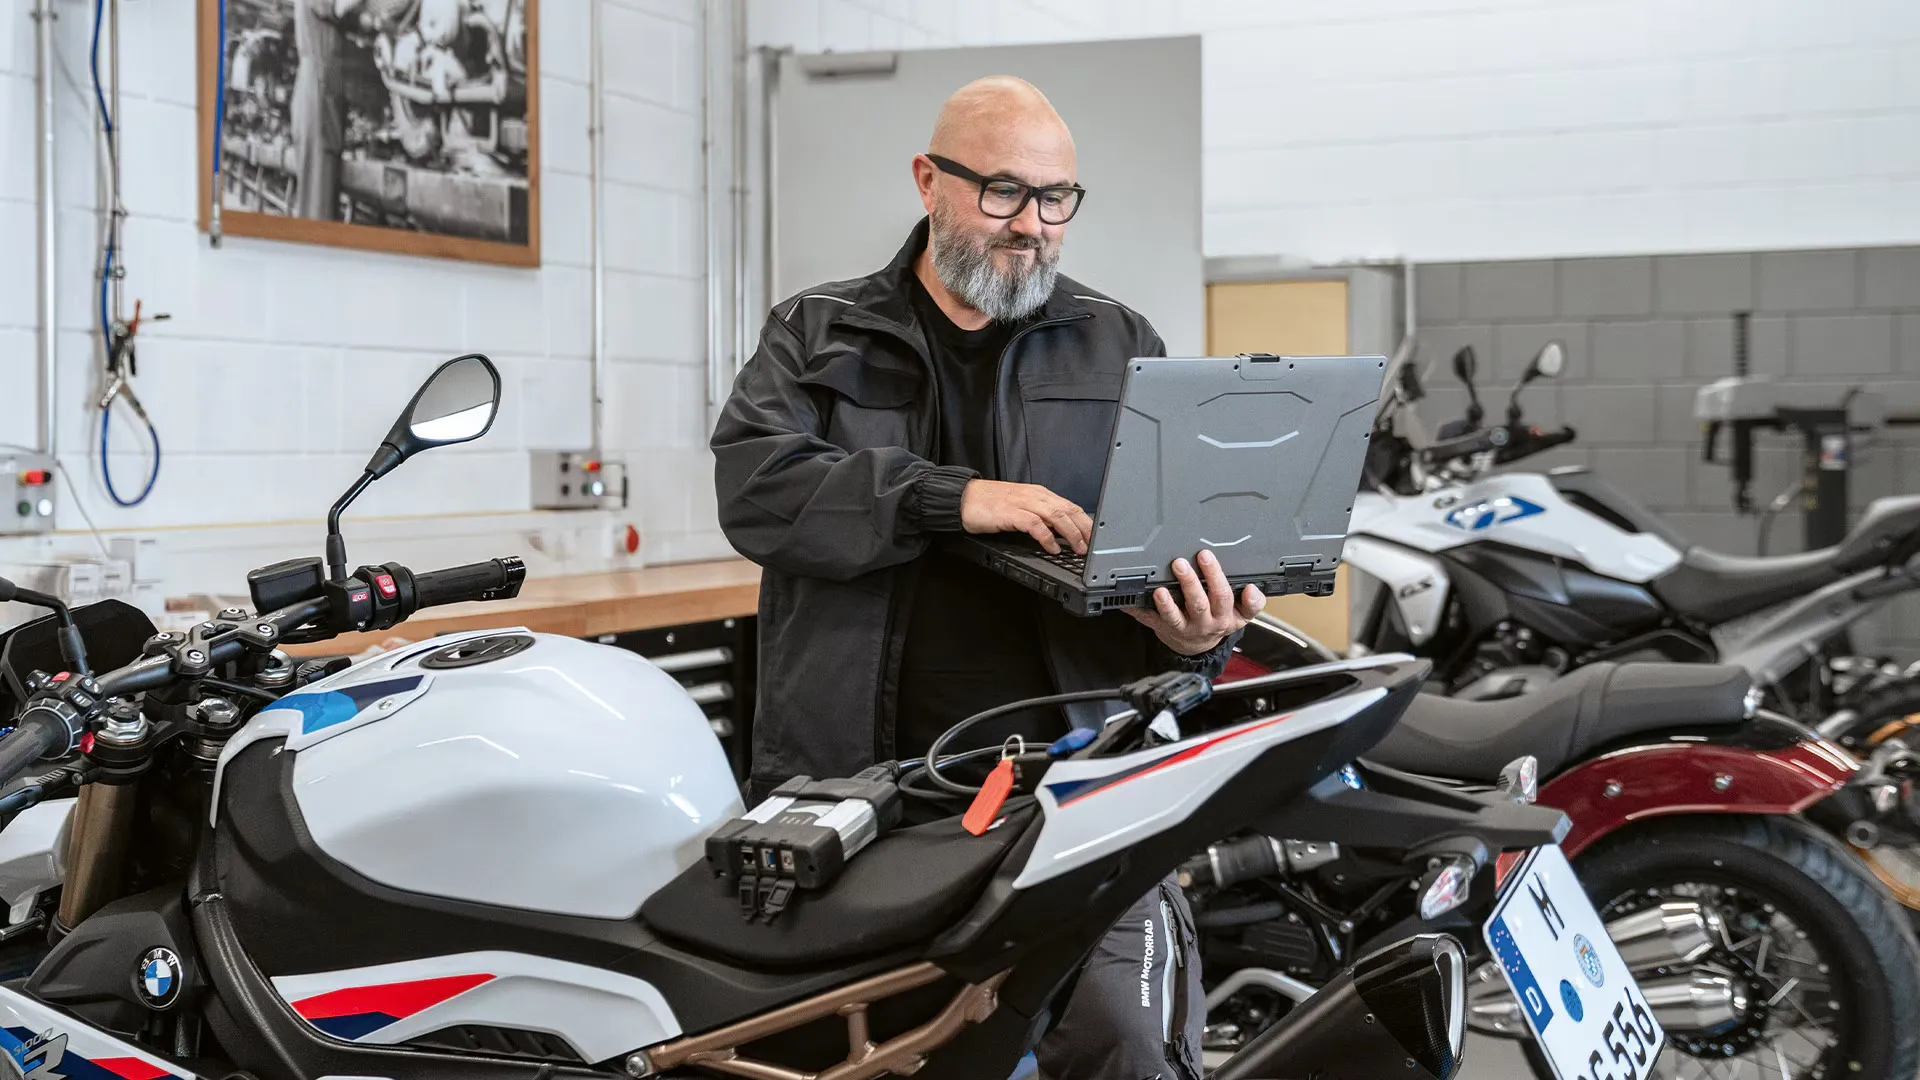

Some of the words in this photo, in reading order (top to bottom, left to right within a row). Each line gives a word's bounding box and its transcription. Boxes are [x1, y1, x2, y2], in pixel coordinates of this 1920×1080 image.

[1527, 872, 1564, 941] M
[141, 949, 177, 970] BMW
[1141, 919, 1155, 979] MOTORRAD
[1141, 980, 1151, 1008] BMW
[1525, 986, 1542, 1016] D
